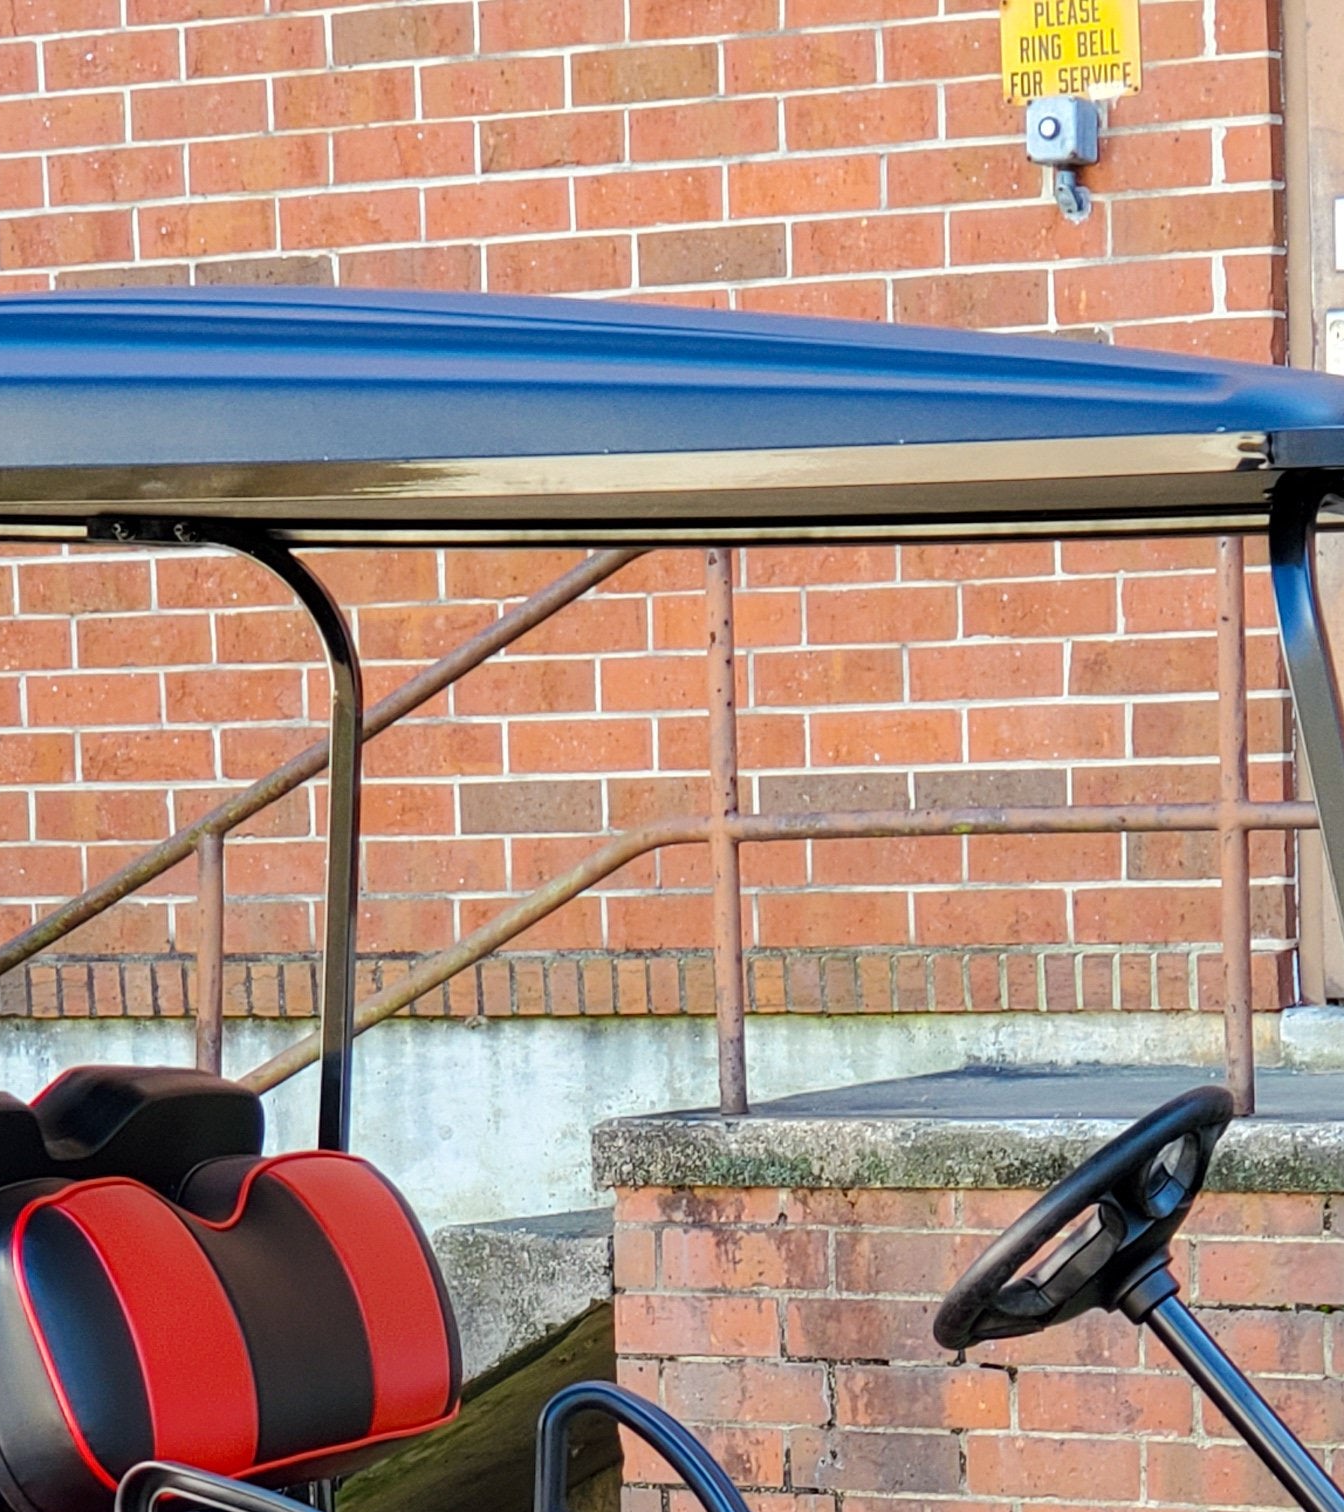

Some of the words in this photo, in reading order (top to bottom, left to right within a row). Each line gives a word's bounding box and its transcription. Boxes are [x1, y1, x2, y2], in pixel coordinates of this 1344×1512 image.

[1033, 0, 1101, 28] PLEASE
[1019, 33, 1062, 63] RING
[1076, 28, 1120, 58] BELL
[1010, 71, 1043, 97] FOR
[1058, 62, 1133, 94] SERVICE
